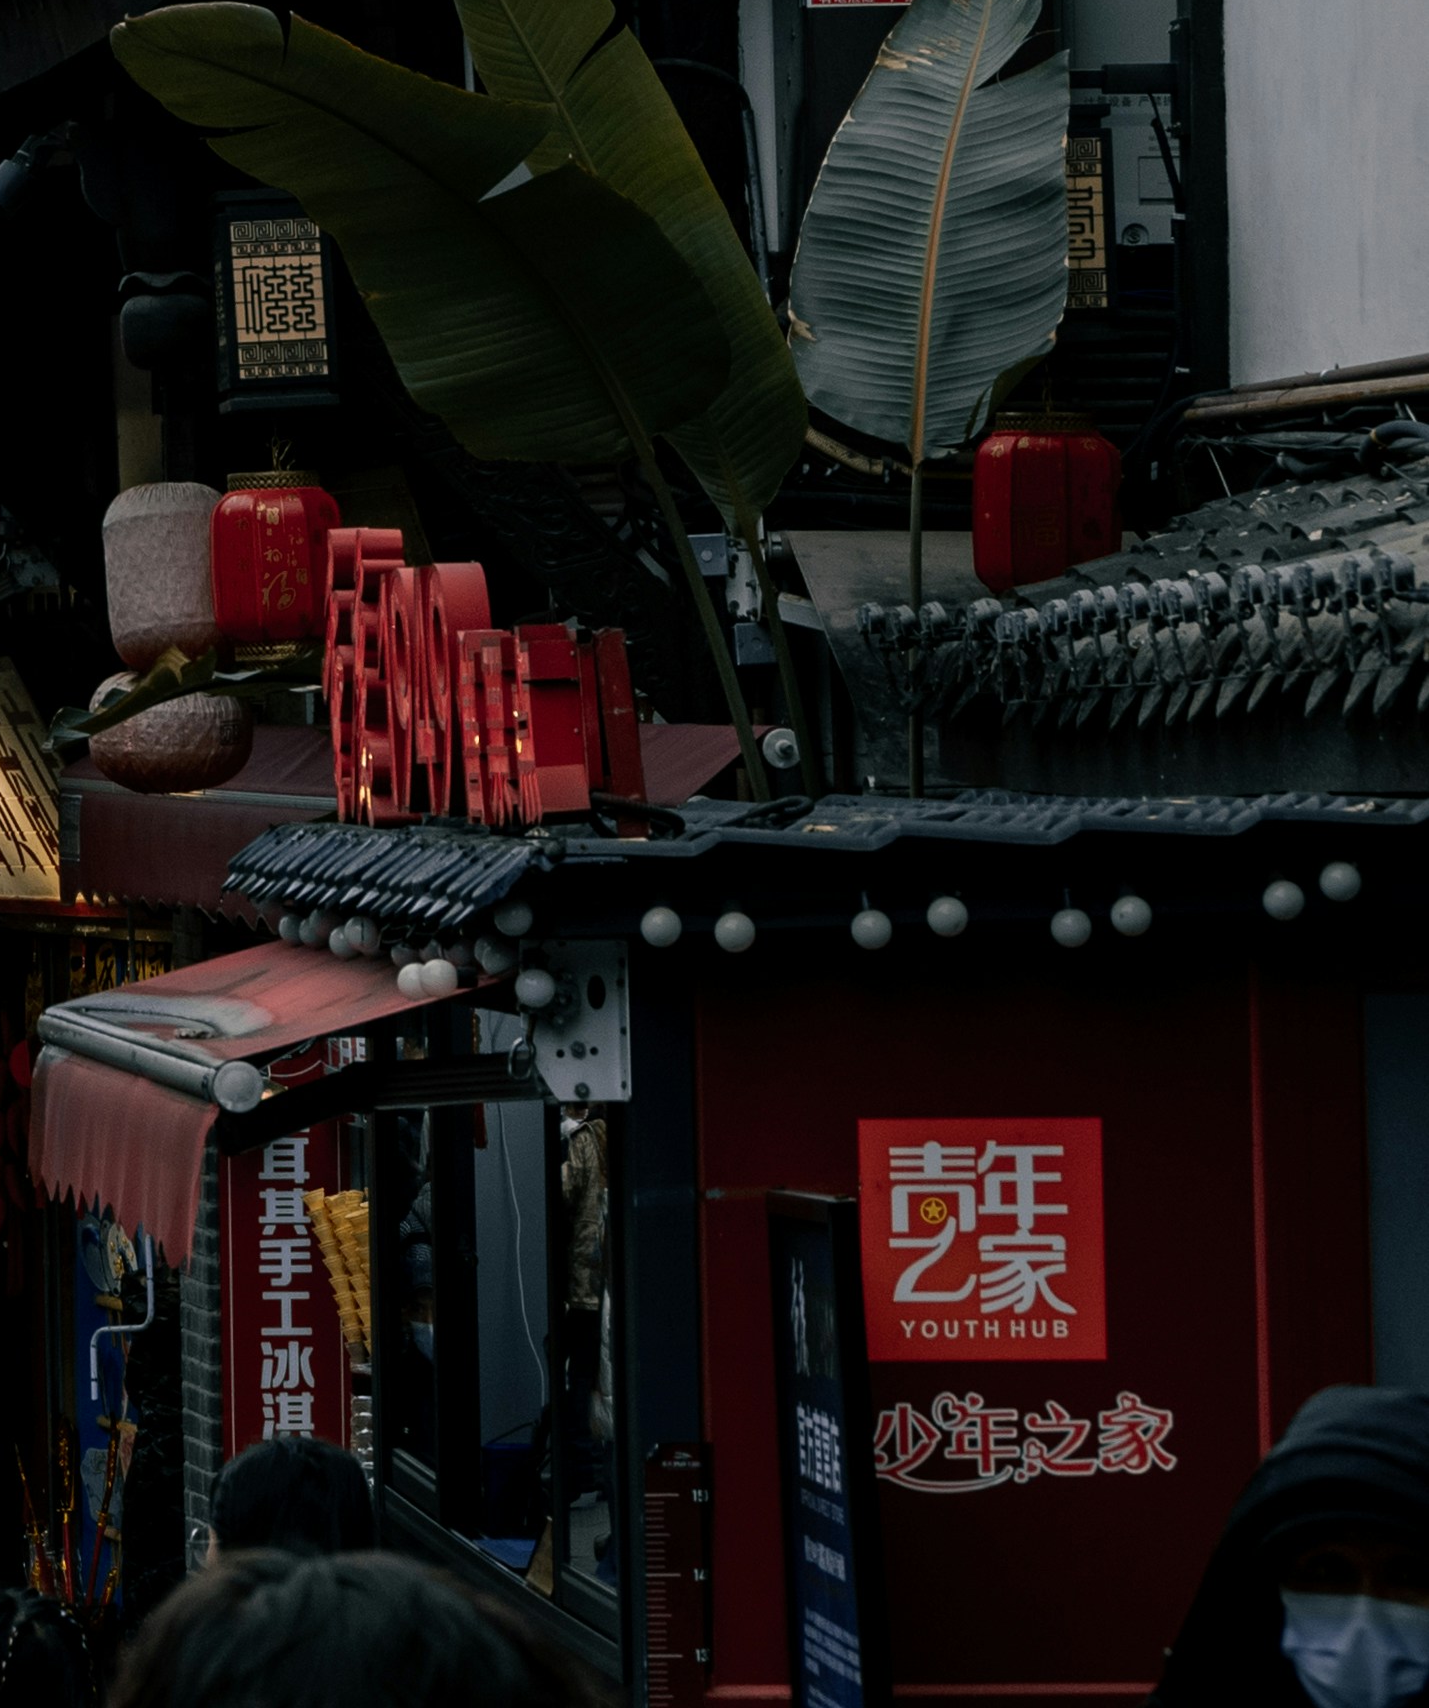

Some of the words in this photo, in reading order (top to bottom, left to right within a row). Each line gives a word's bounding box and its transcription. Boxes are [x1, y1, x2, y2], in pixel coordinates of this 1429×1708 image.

[889, 1140, 1070, 1233] 青年
[258, 1126, 316, 1440] 耳其手工冰淇
[889, 1215, 1079, 1316] 之家
[900, 1319, 1001, 1339] YOUTH
[1010, 1319, 1070, 1339] HUB
[873, 1390, 1179, 1494] 少年之家
